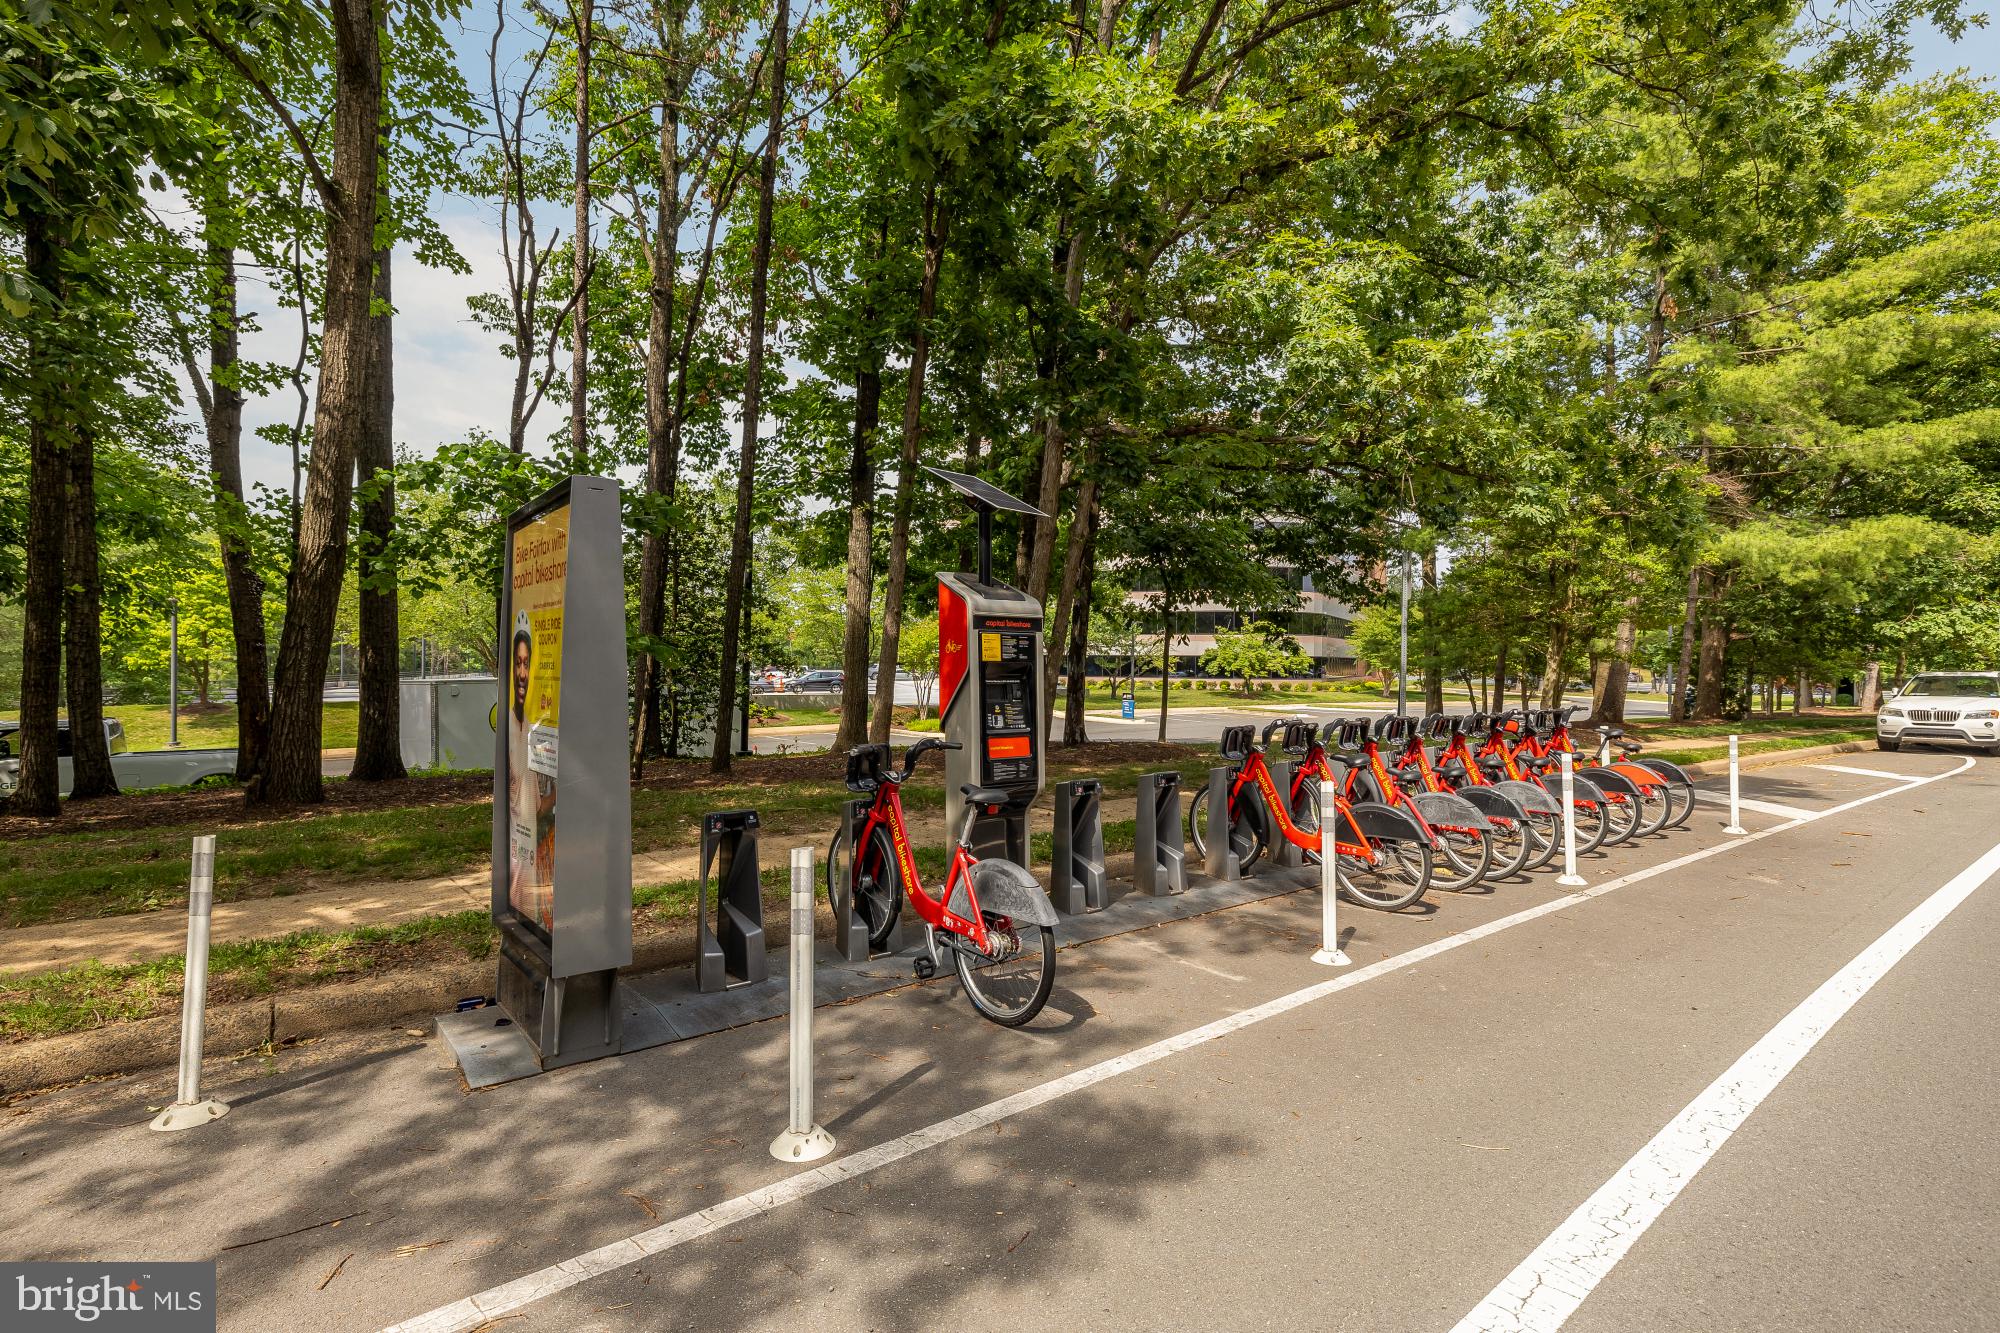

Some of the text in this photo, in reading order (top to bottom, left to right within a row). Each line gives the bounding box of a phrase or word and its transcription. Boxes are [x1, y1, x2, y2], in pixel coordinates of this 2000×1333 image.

[516, 529, 566, 564] Bike Fairfax with
[513, 564, 533, 594] capital
[1255, 768, 1288, 831] capital bikeshare
[887, 804, 915, 895] capital bikeshare
